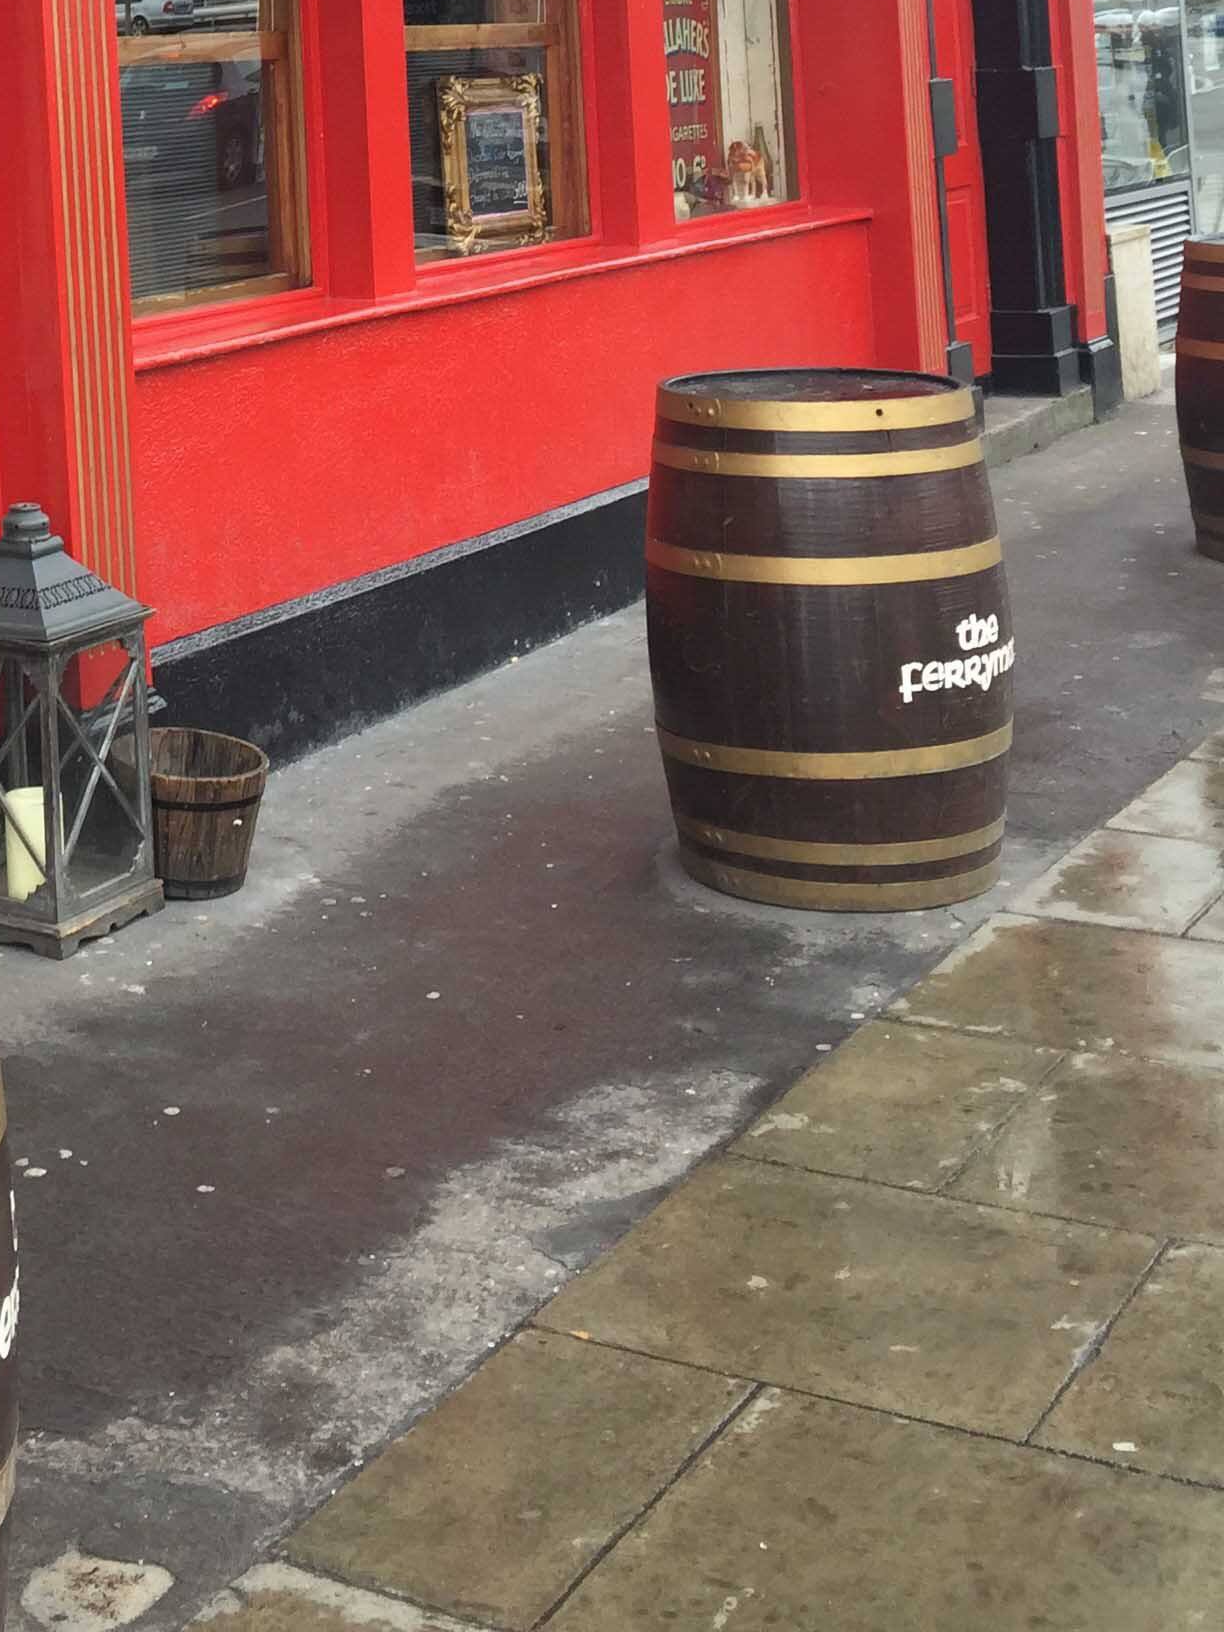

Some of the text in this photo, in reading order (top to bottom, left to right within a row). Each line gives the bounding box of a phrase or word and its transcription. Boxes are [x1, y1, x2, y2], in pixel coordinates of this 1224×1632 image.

[663, 16, 711, 60] LLAHER'S
[680, 68, 706, 102] LUXE
[670, 123, 708, 142] IGARETTES
[955, 613, 999, 652] the
